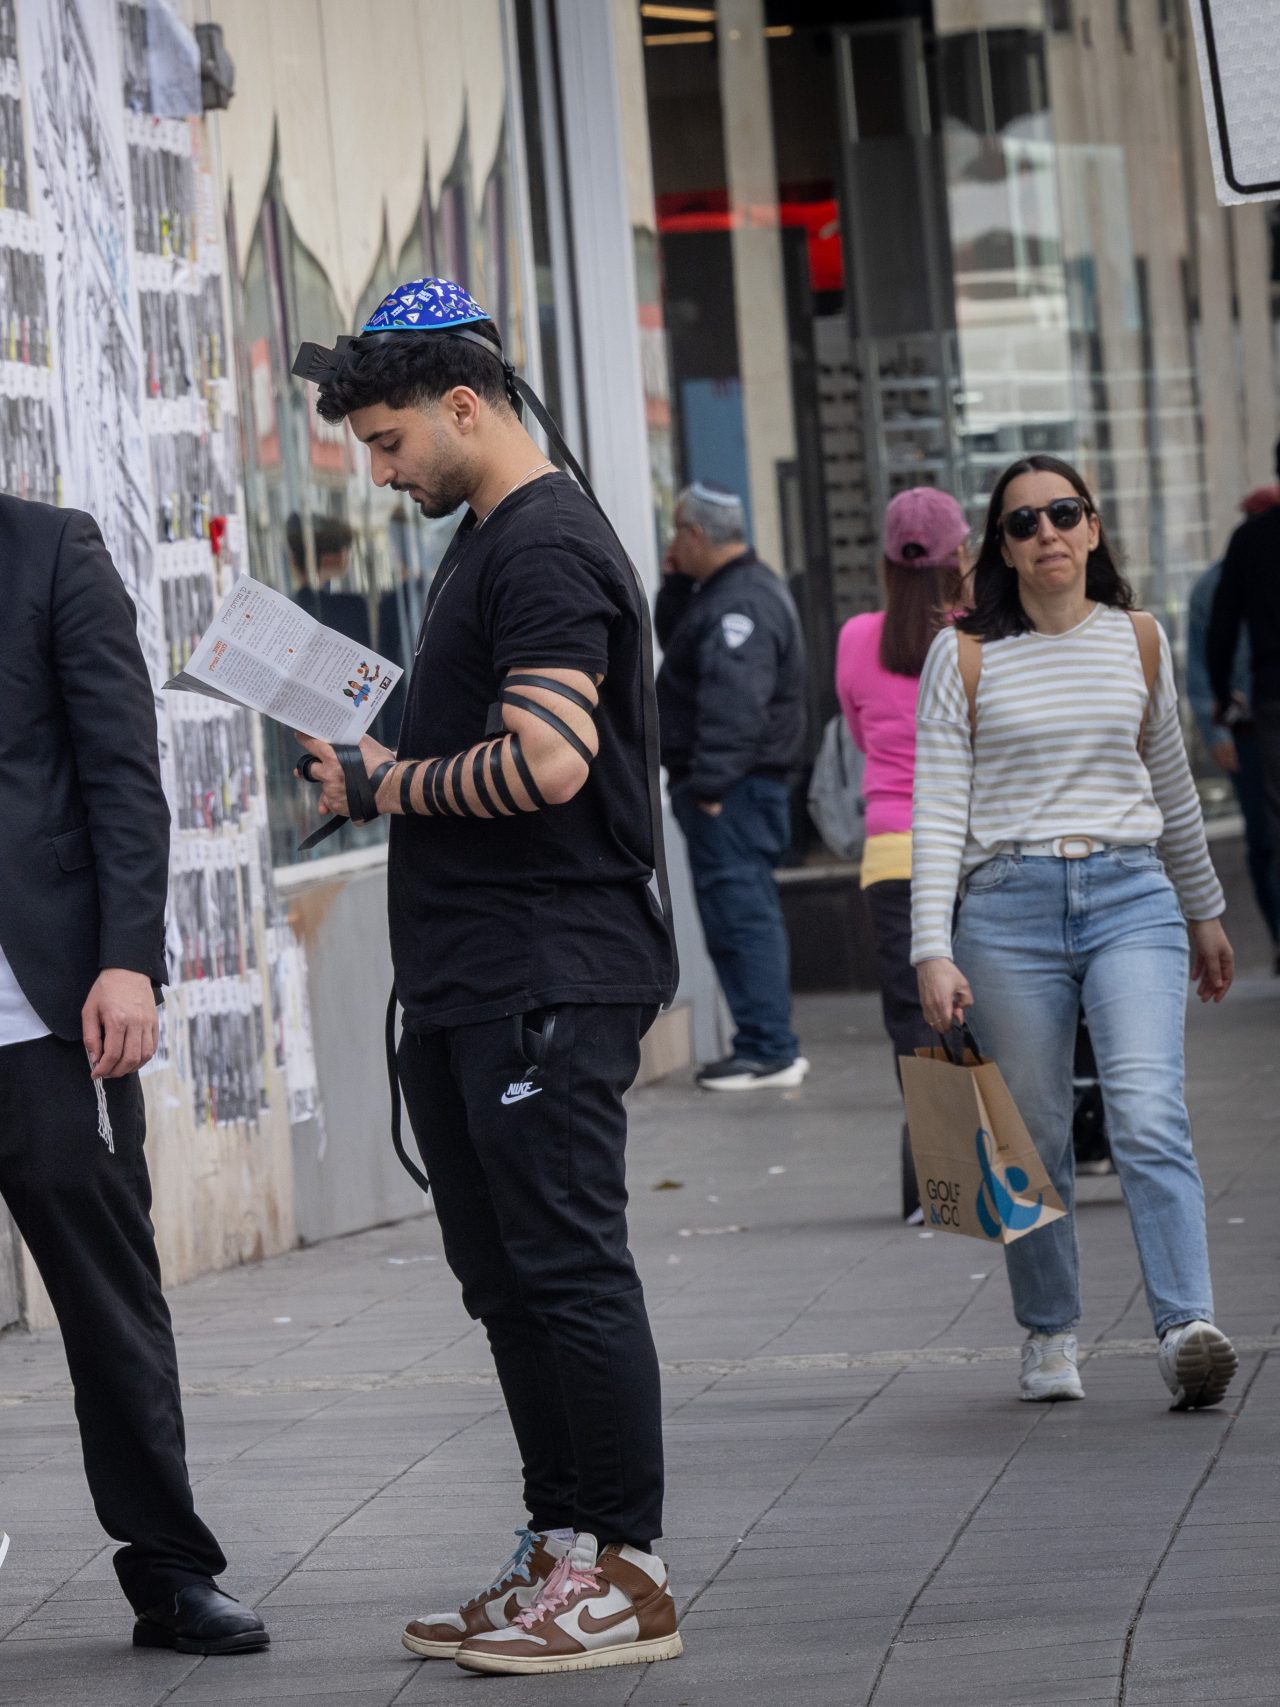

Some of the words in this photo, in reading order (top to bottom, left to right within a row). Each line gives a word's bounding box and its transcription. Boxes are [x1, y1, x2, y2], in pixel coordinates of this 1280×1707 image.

[507, 1081, 533, 1095] NIKE
[926, 1178, 960, 1204] GOLF
[930, 1203, 960, 1228] &CO
